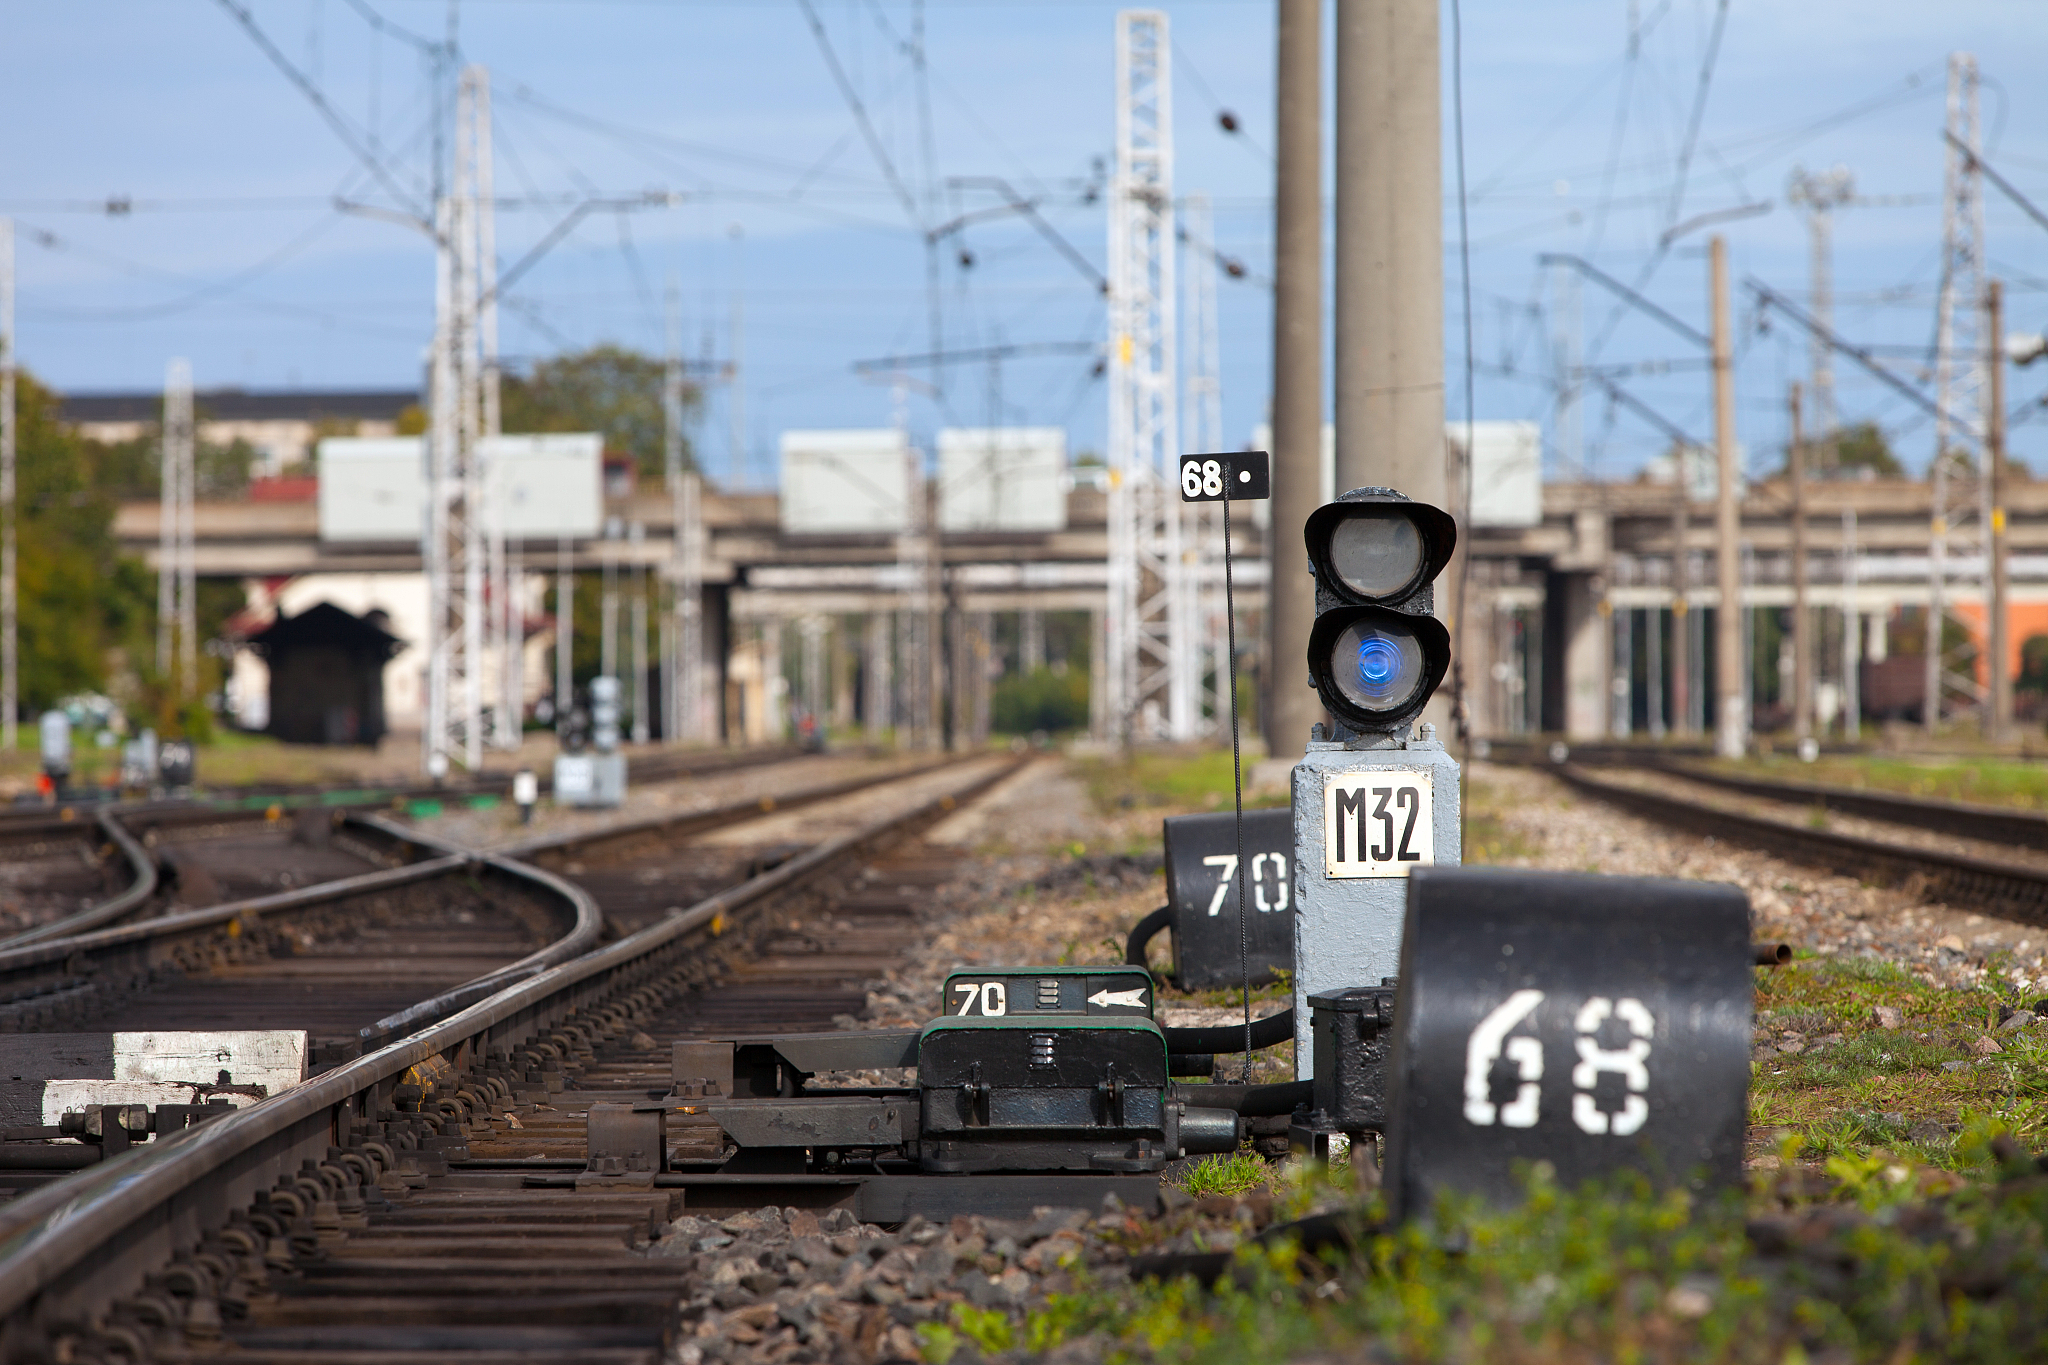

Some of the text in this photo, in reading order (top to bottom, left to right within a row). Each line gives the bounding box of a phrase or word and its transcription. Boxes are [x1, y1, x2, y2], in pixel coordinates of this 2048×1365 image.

[1181, 460, 1222, 497] 68
[1336, 787, 1420, 862] M32
[1203, 852, 1288, 916] 70
[955, 982, 1005, 1016] 70
[1463, 989, 1655, 1136] 68
